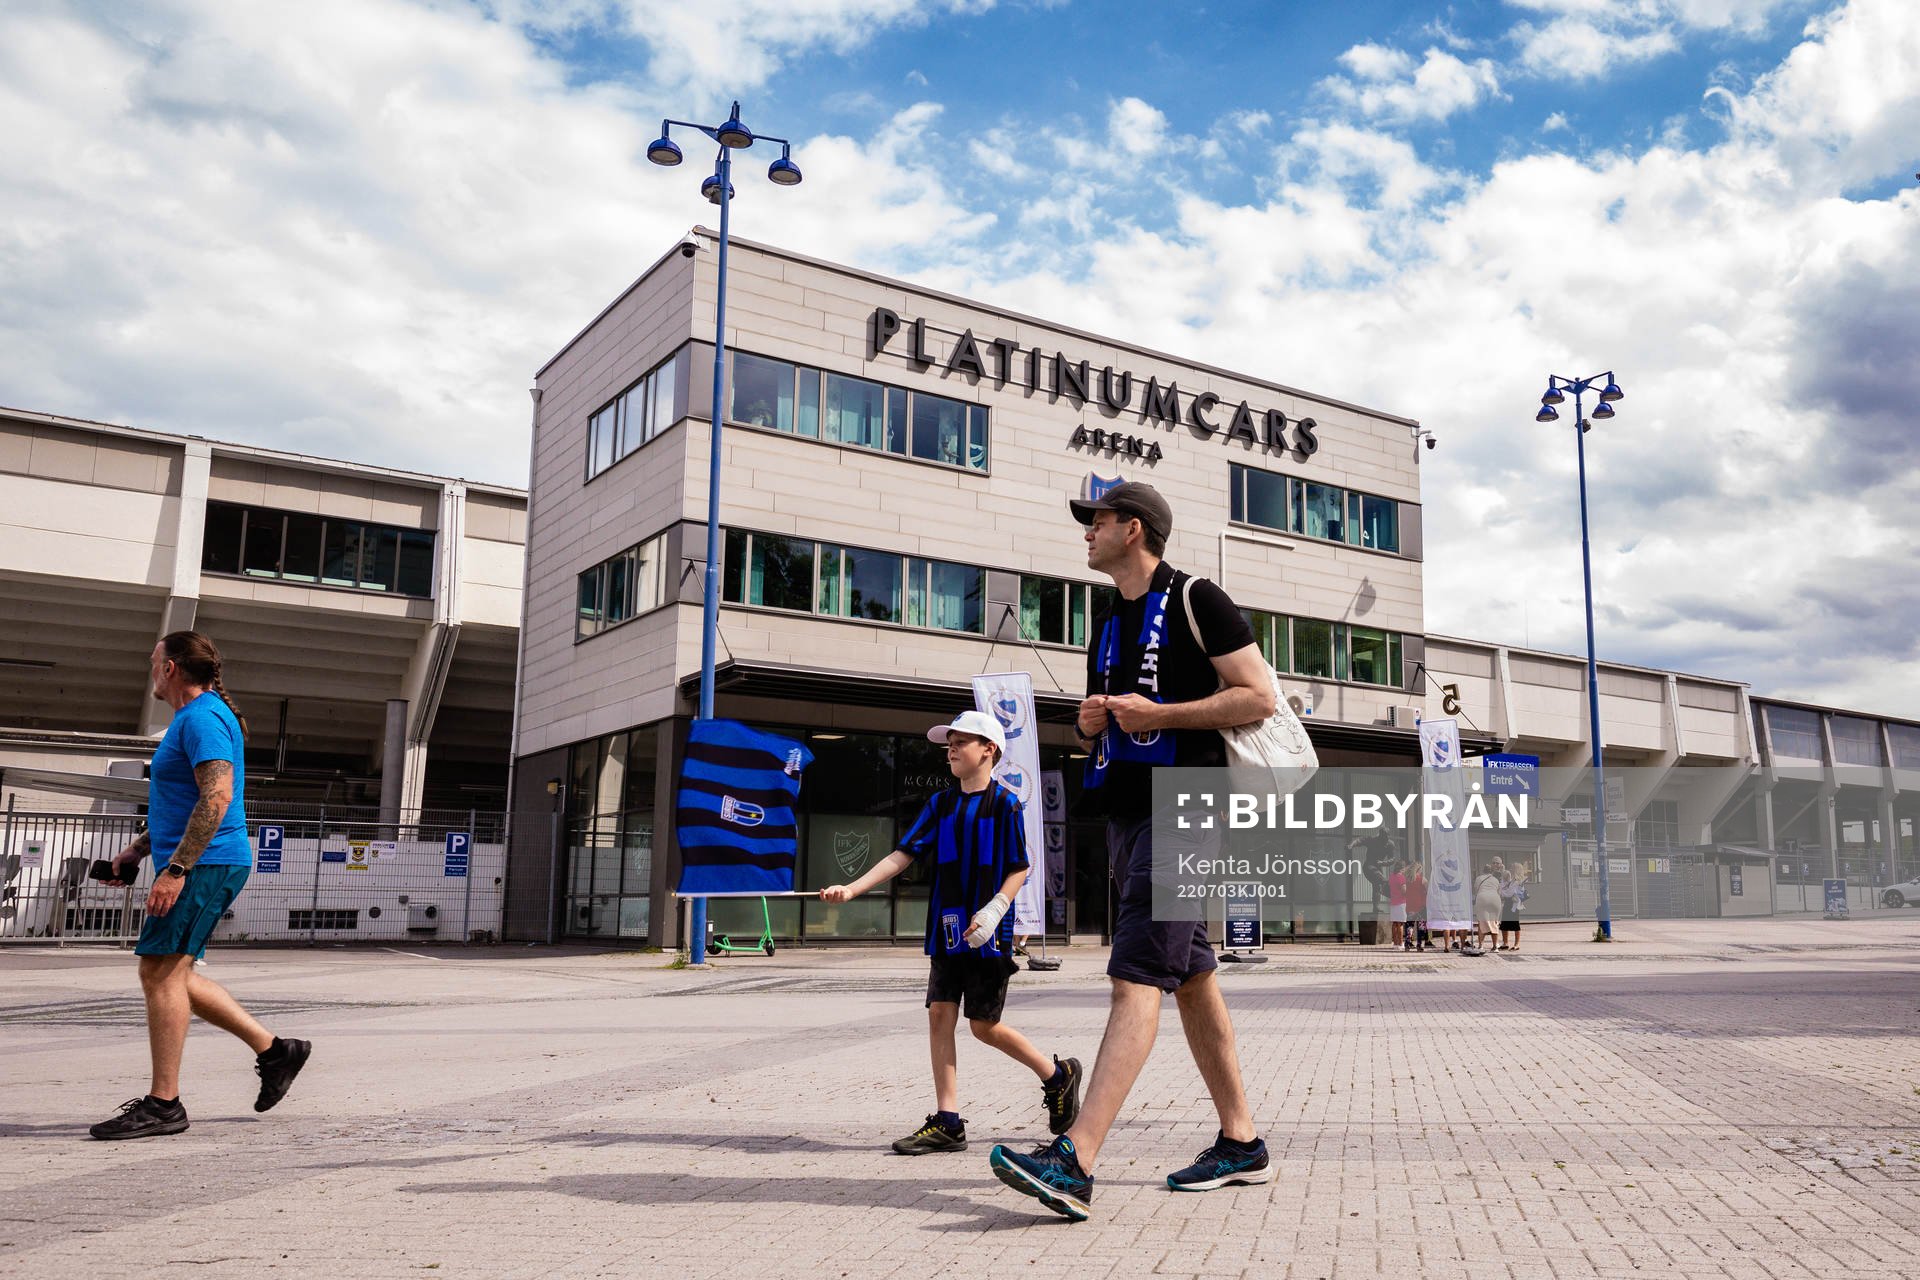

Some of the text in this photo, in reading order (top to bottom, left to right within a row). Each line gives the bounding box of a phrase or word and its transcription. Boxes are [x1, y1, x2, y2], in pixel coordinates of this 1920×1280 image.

[875, 306, 1318, 456] PLATINUMCARS
[1075, 423, 1163, 460] ARENA
[1490, 775, 1513, 786] Entré
[264, 828, 280, 848] P
[451, 835, 466, 853] P
